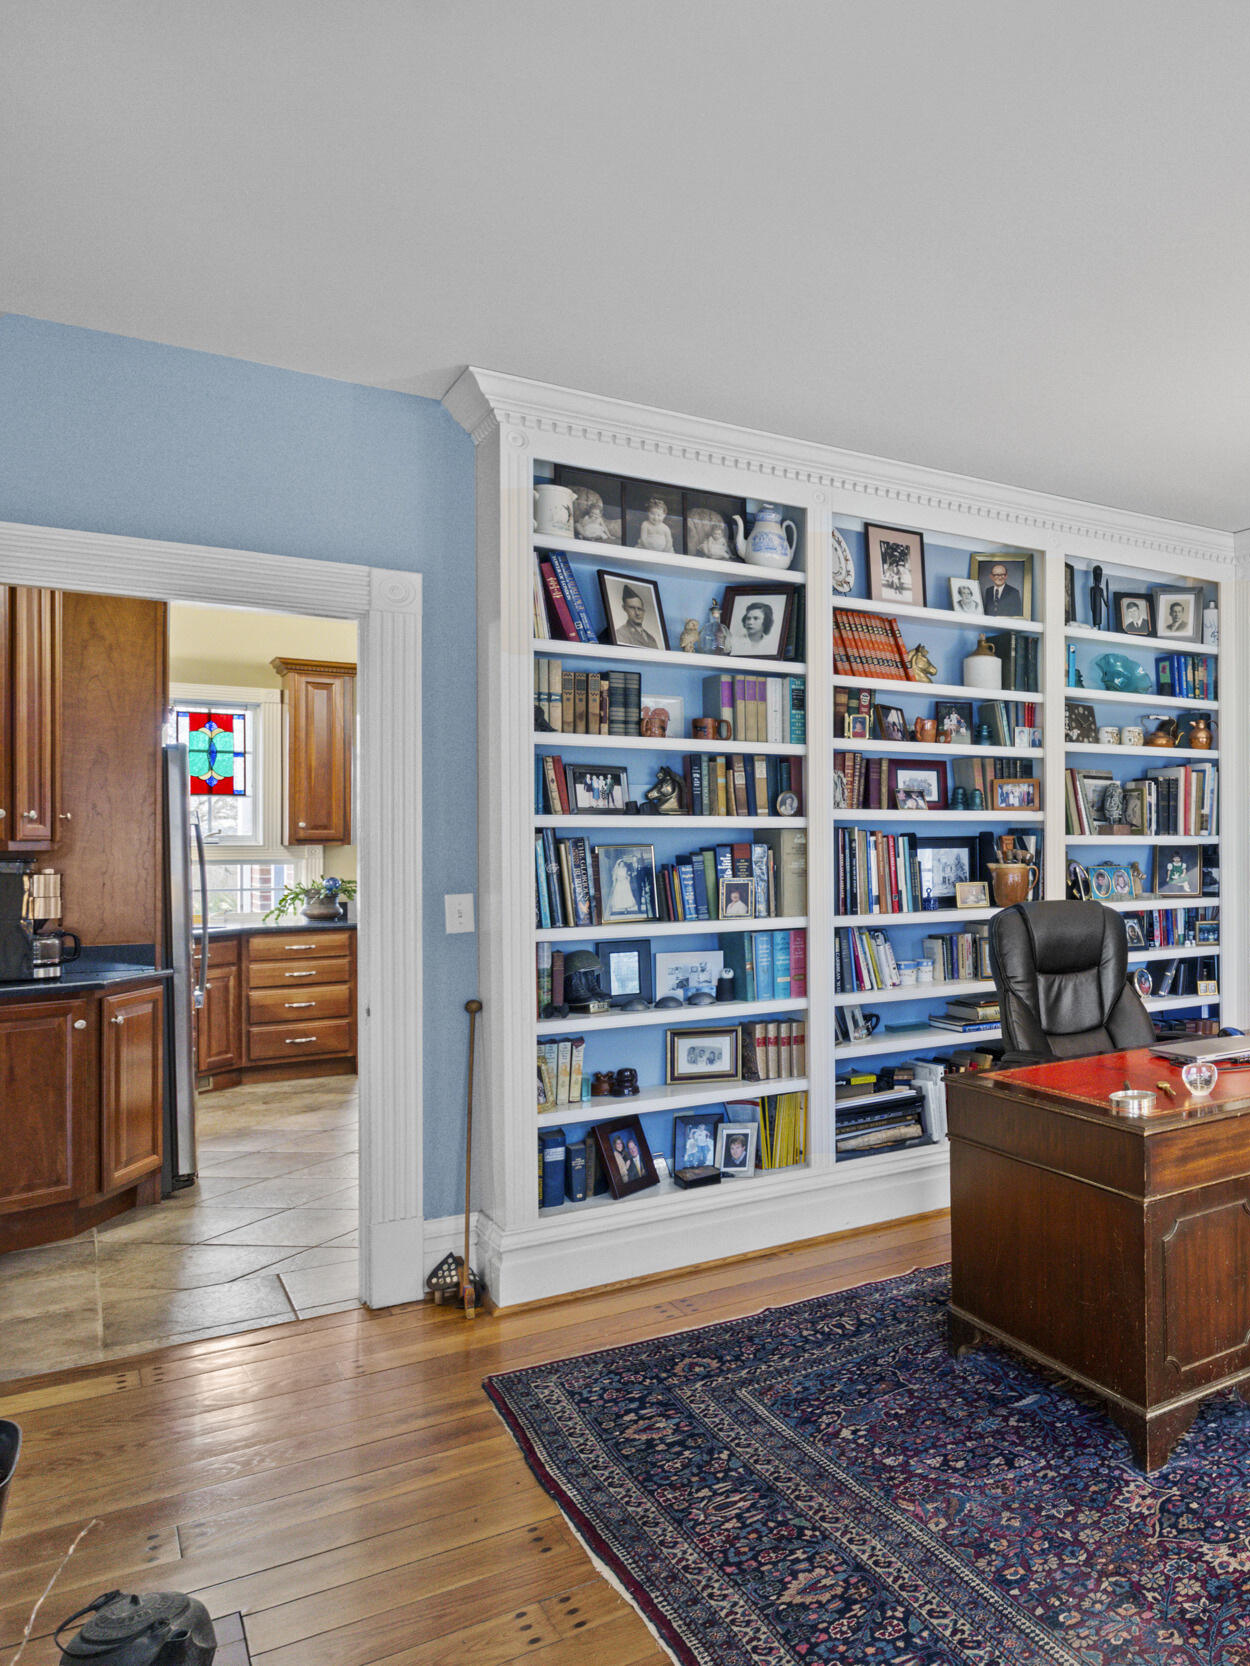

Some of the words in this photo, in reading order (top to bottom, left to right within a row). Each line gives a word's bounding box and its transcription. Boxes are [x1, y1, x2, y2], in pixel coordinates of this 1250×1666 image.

[560, 581, 571, 601] LONDON
[577, 841, 585, 859] THE
[574, 867, 584, 902] BURDEN
[580, 860, 590, 901] GLORIOUS
